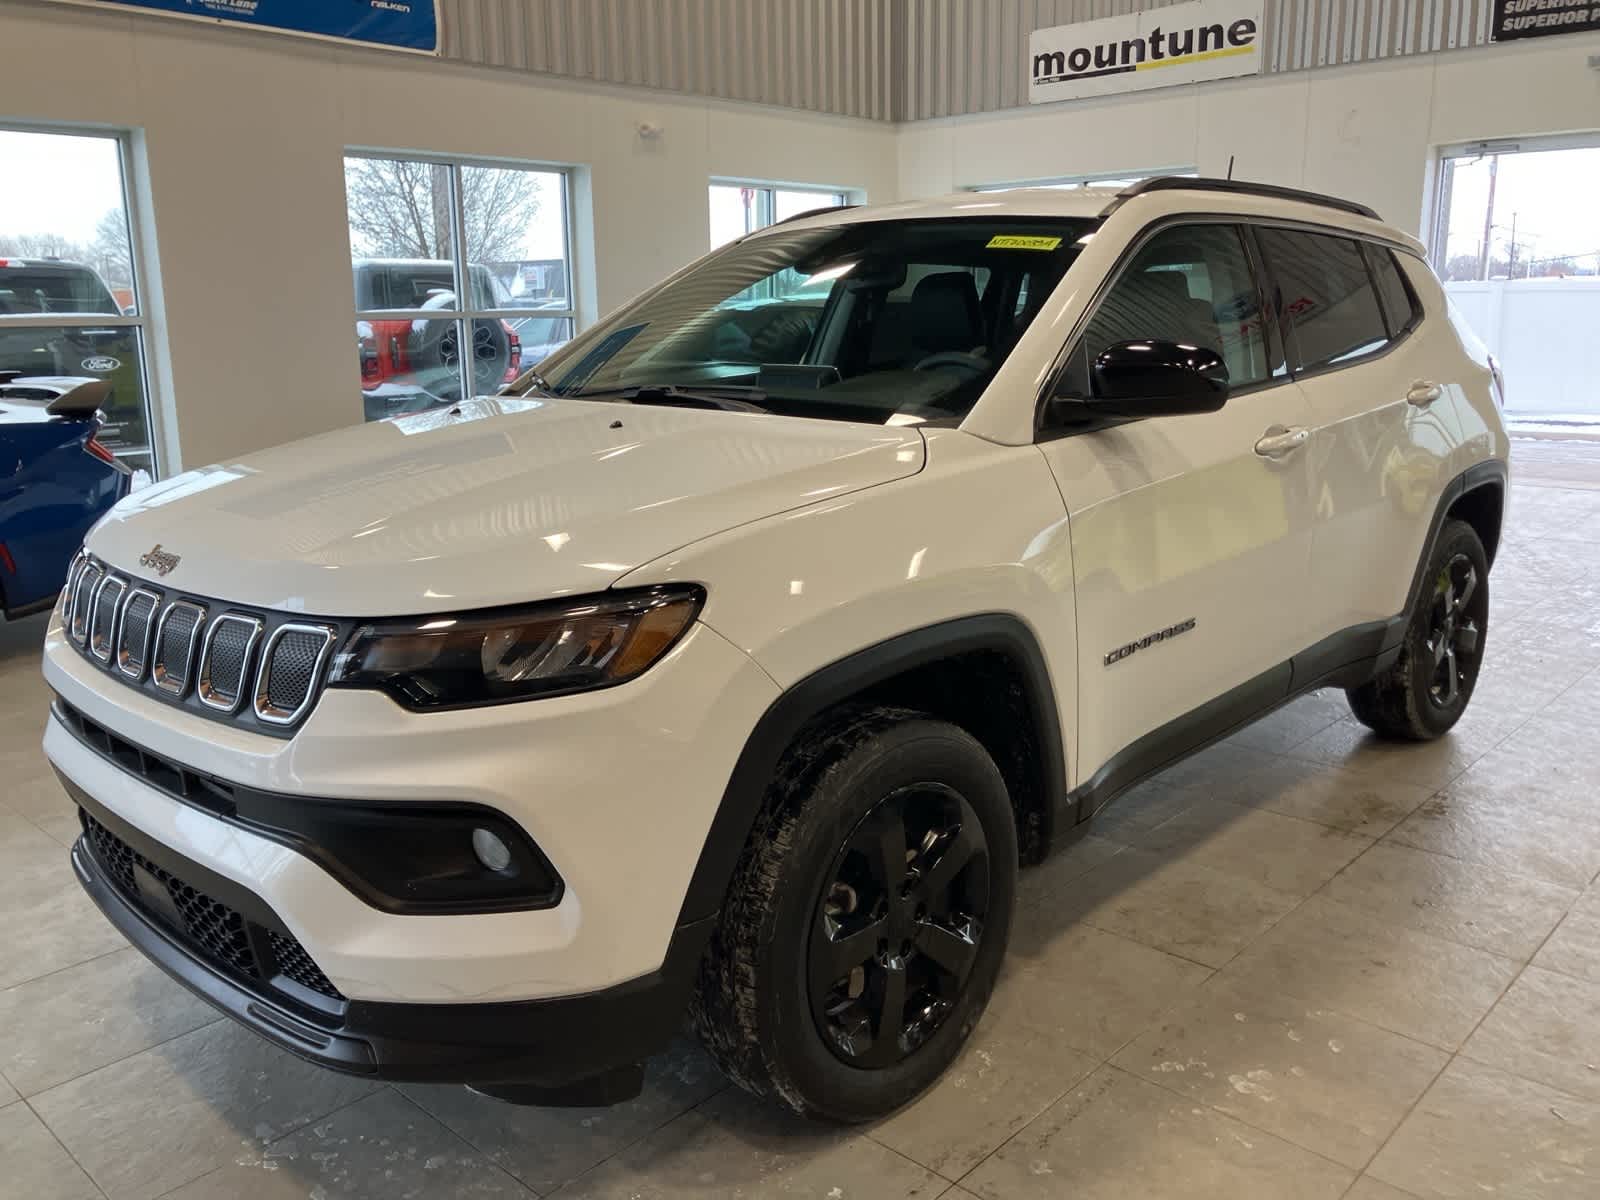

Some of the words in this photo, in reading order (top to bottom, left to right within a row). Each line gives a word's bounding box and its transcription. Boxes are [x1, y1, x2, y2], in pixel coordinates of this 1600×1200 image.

[371, 0, 410, 13] FALKEN
[1502, 9, 1589, 31] SUPERIOR
[1033, 18, 1257, 78] mountune
[1103, 617, 1196, 667] COMPASS
